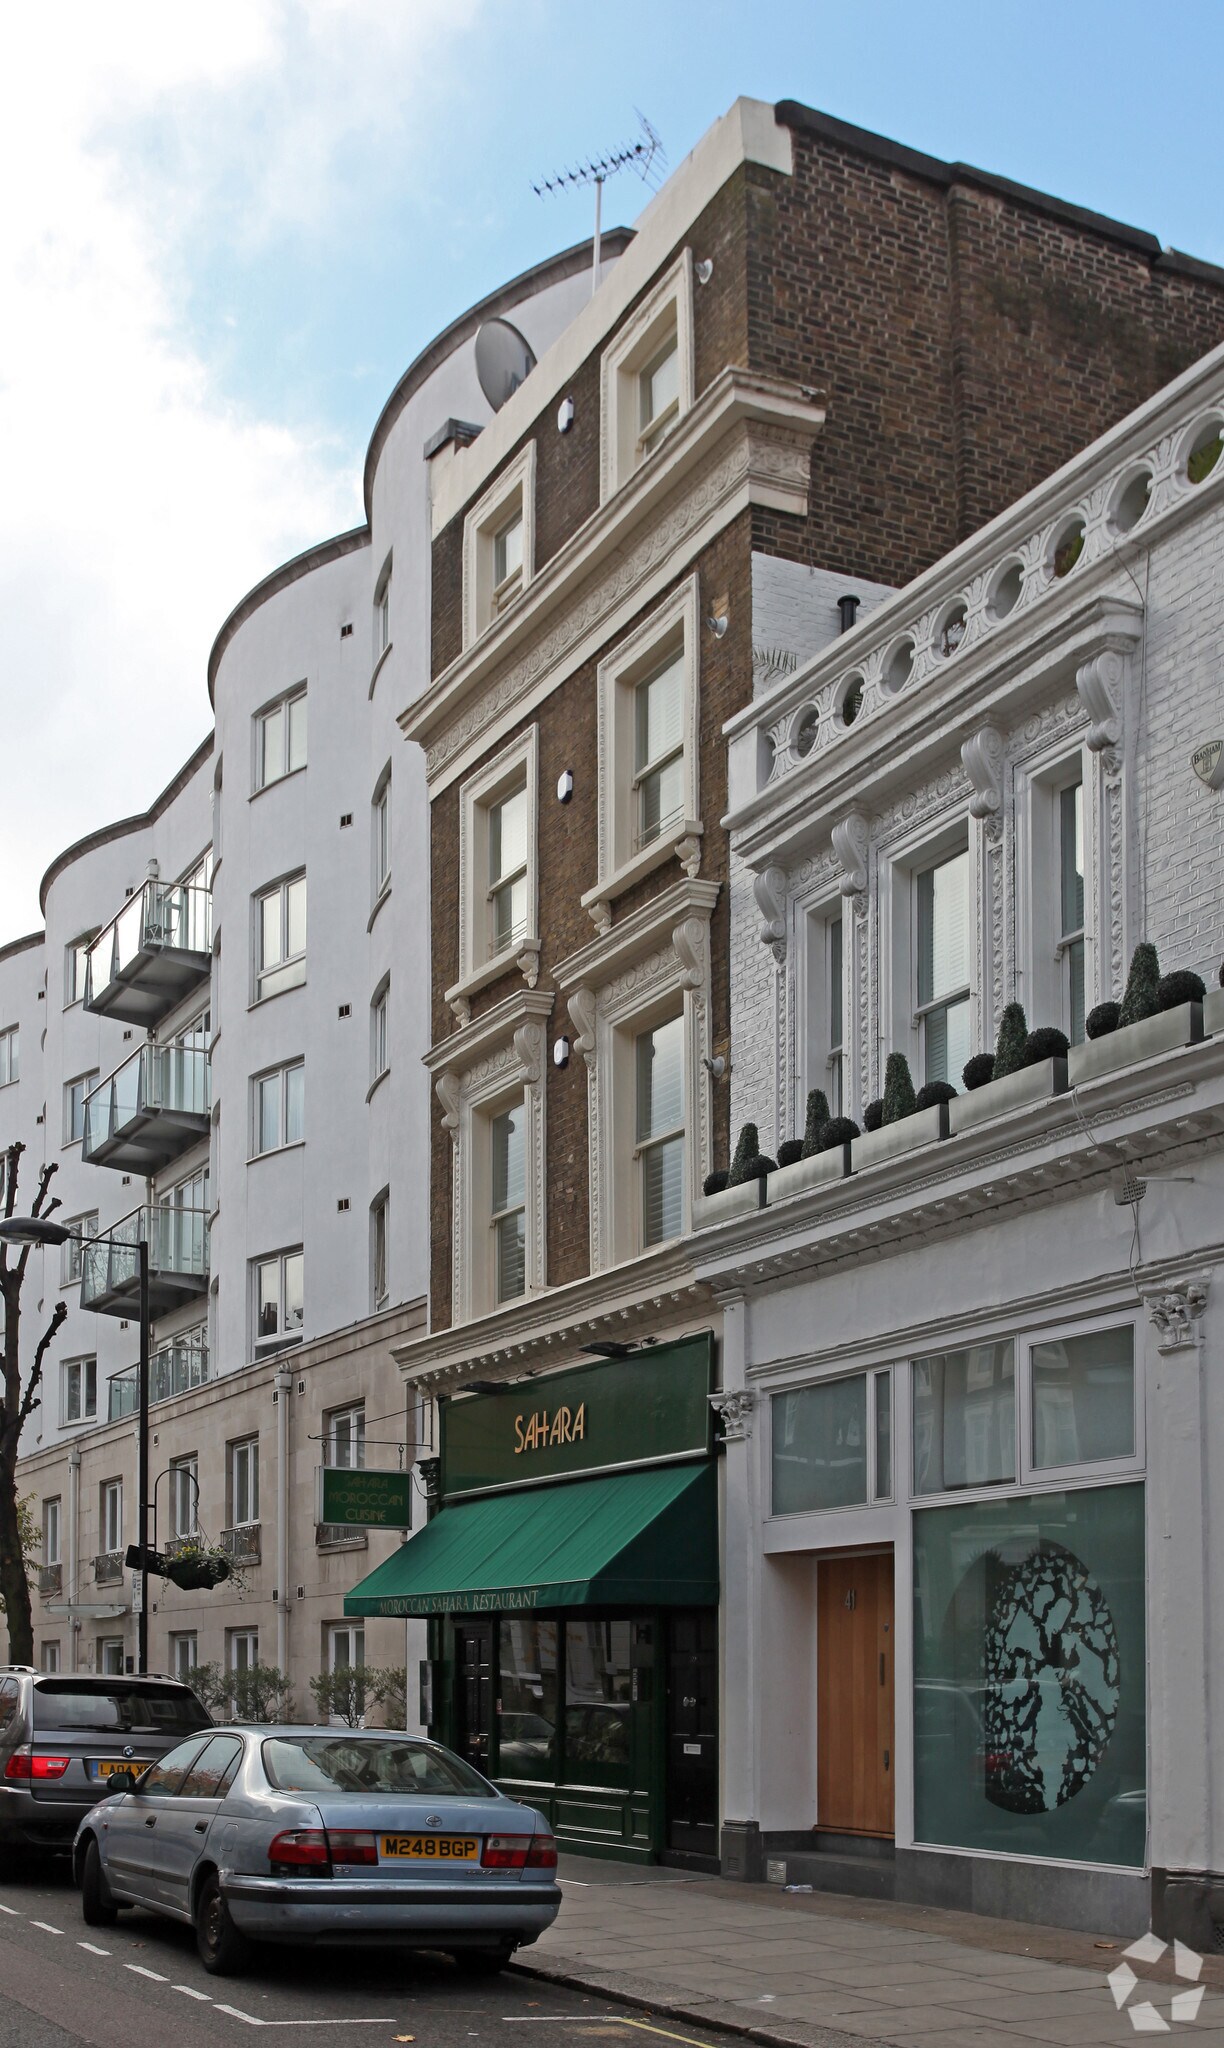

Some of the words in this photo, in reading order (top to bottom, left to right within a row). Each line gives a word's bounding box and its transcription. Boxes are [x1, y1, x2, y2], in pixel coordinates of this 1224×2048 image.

[1194, 742, 1221, 764] BANHAM
[514, 1402, 585, 1453] SAHARA
[344, 1474, 389, 1488] SAHARA
[328, 1491, 403, 1506] MOROCCAN
[345, 1508, 387, 1522] CUISINE
[380, 1597, 429, 1614] MOROCCAN
[432, 1595, 469, 1612] SAHARA
[472, 1590, 539, 1610] RESTAURANT
[844, 1589, 855, 1610] 41
